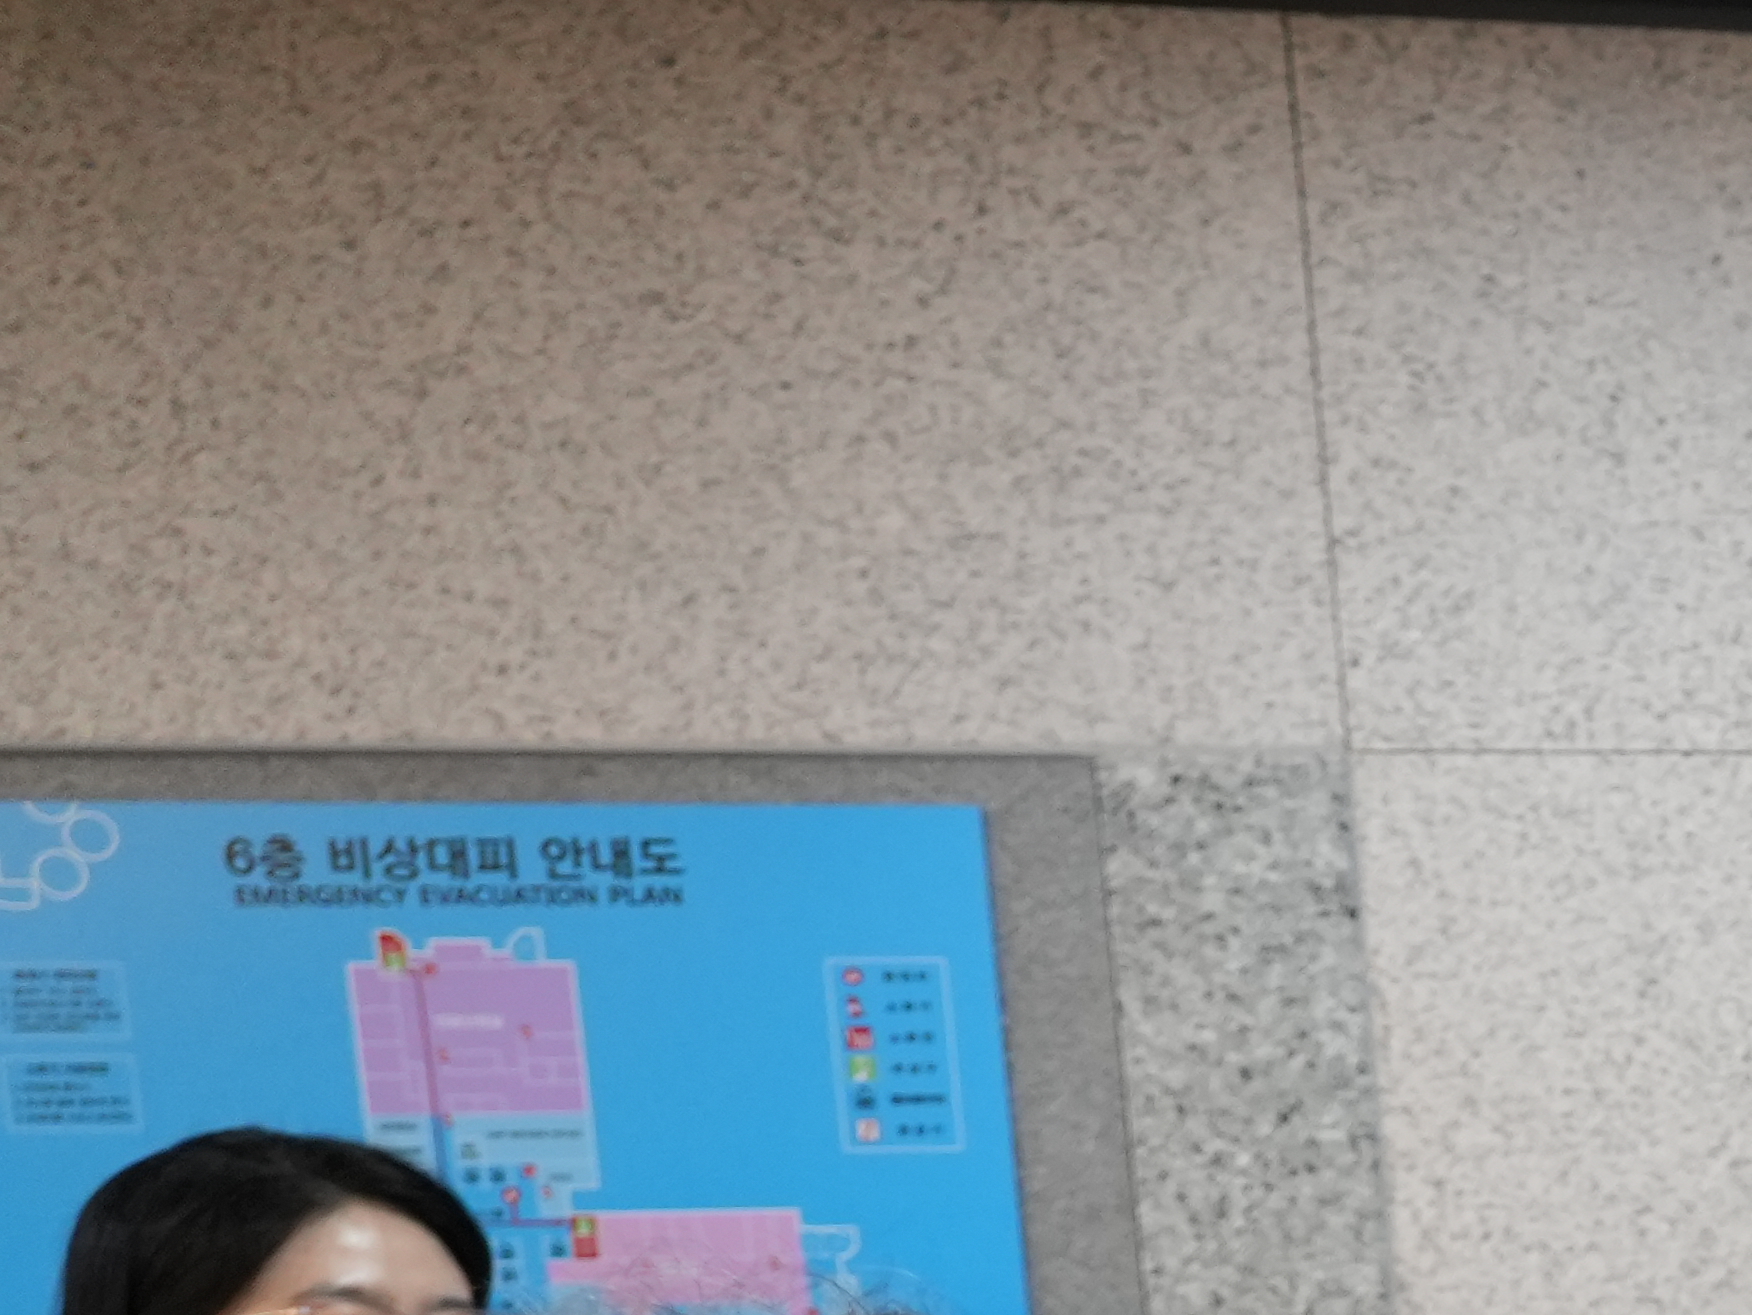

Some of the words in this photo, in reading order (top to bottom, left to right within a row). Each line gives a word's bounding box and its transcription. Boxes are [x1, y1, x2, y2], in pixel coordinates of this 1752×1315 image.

[223, 834, 308, 881] 6층
[328, 835, 521, 882] 비상대피
[539, 834, 688, 881] 안내도
[232, 882, 408, 909] EMERGENCY
[418, 882, 598, 909] EVACUATION
[605, 882, 686, 909] PLAN
